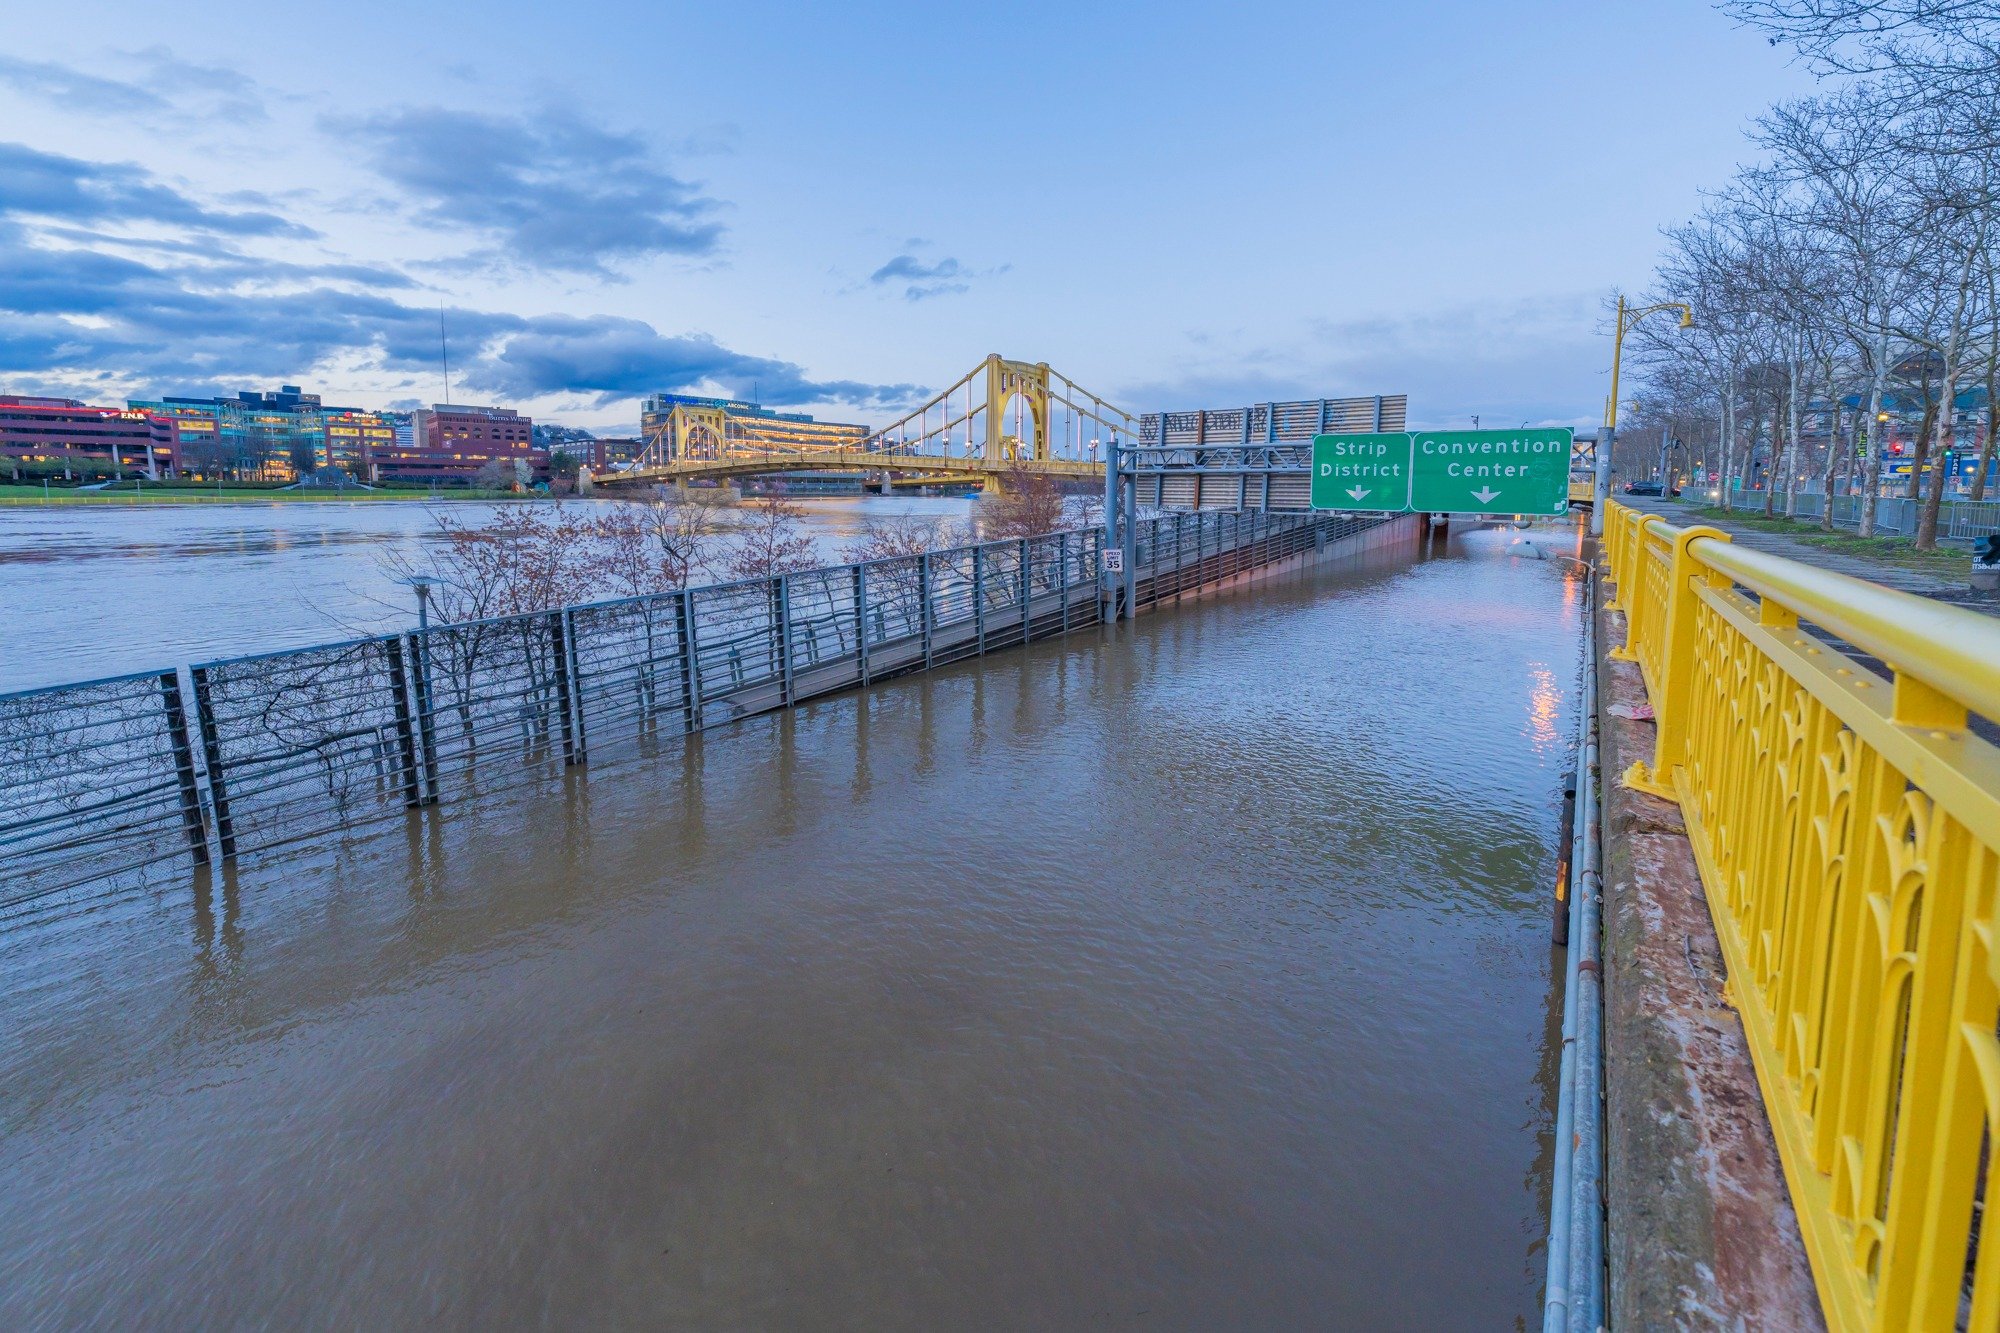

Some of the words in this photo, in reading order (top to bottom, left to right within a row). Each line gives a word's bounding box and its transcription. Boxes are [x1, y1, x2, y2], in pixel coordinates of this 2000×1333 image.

[1336, 442, 1387, 458] Strip
[1422, 438, 1561, 455] Convention
[1320, 463, 1400, 477] District
[1447, 462, 1528, 477] Center
[1107, 560, 1120, 569] 35
